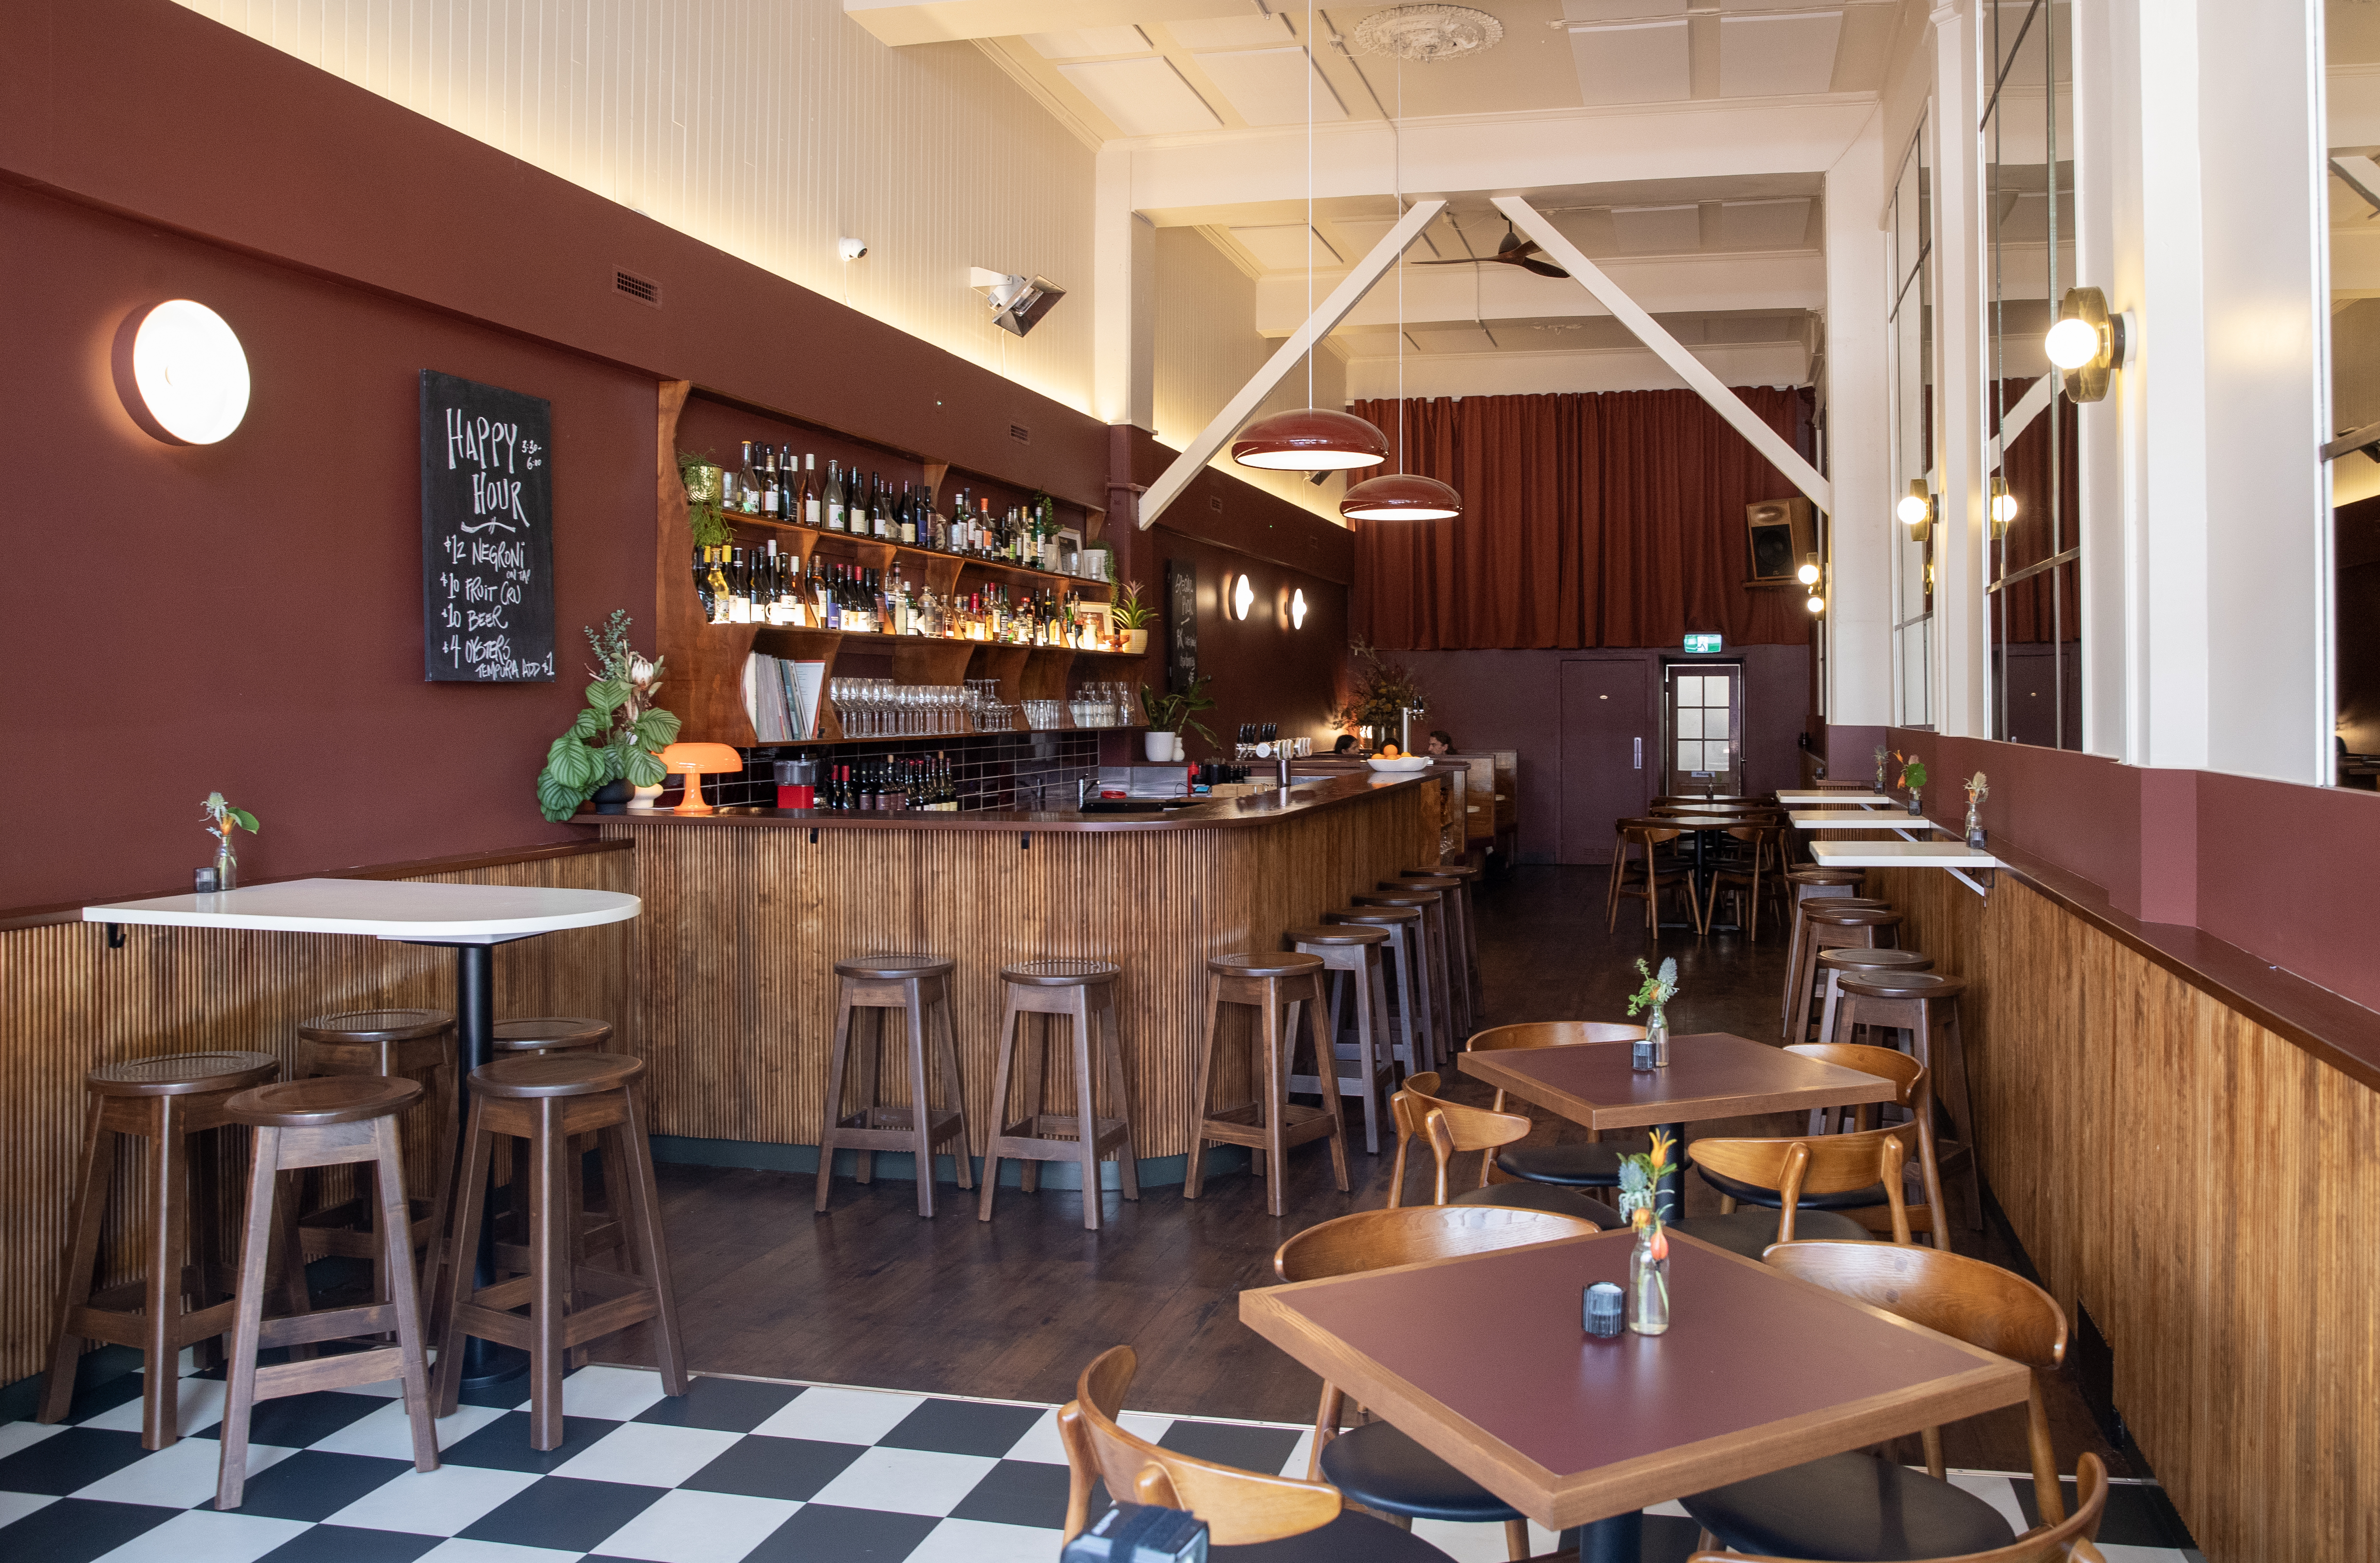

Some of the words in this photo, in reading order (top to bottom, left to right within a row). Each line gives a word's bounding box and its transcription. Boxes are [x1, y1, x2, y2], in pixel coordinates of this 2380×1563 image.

[446, 408, 518, 474] HAPPY
[472, 471, 530, 528] HOUR
[443, 534, 466, 565] $12
[440, 571, 460, 599] $10
[441, 602, 462, 627] $10
[466, 605, 509, 632] BEER
[442, 634, 462, 669] $4
[465, 634, 511, 665] OYSTERS
[475, 659, 520, 680] TEMPURA
[521, 658, 541, 678] ADD
[541, 651, 555, 677] $1
